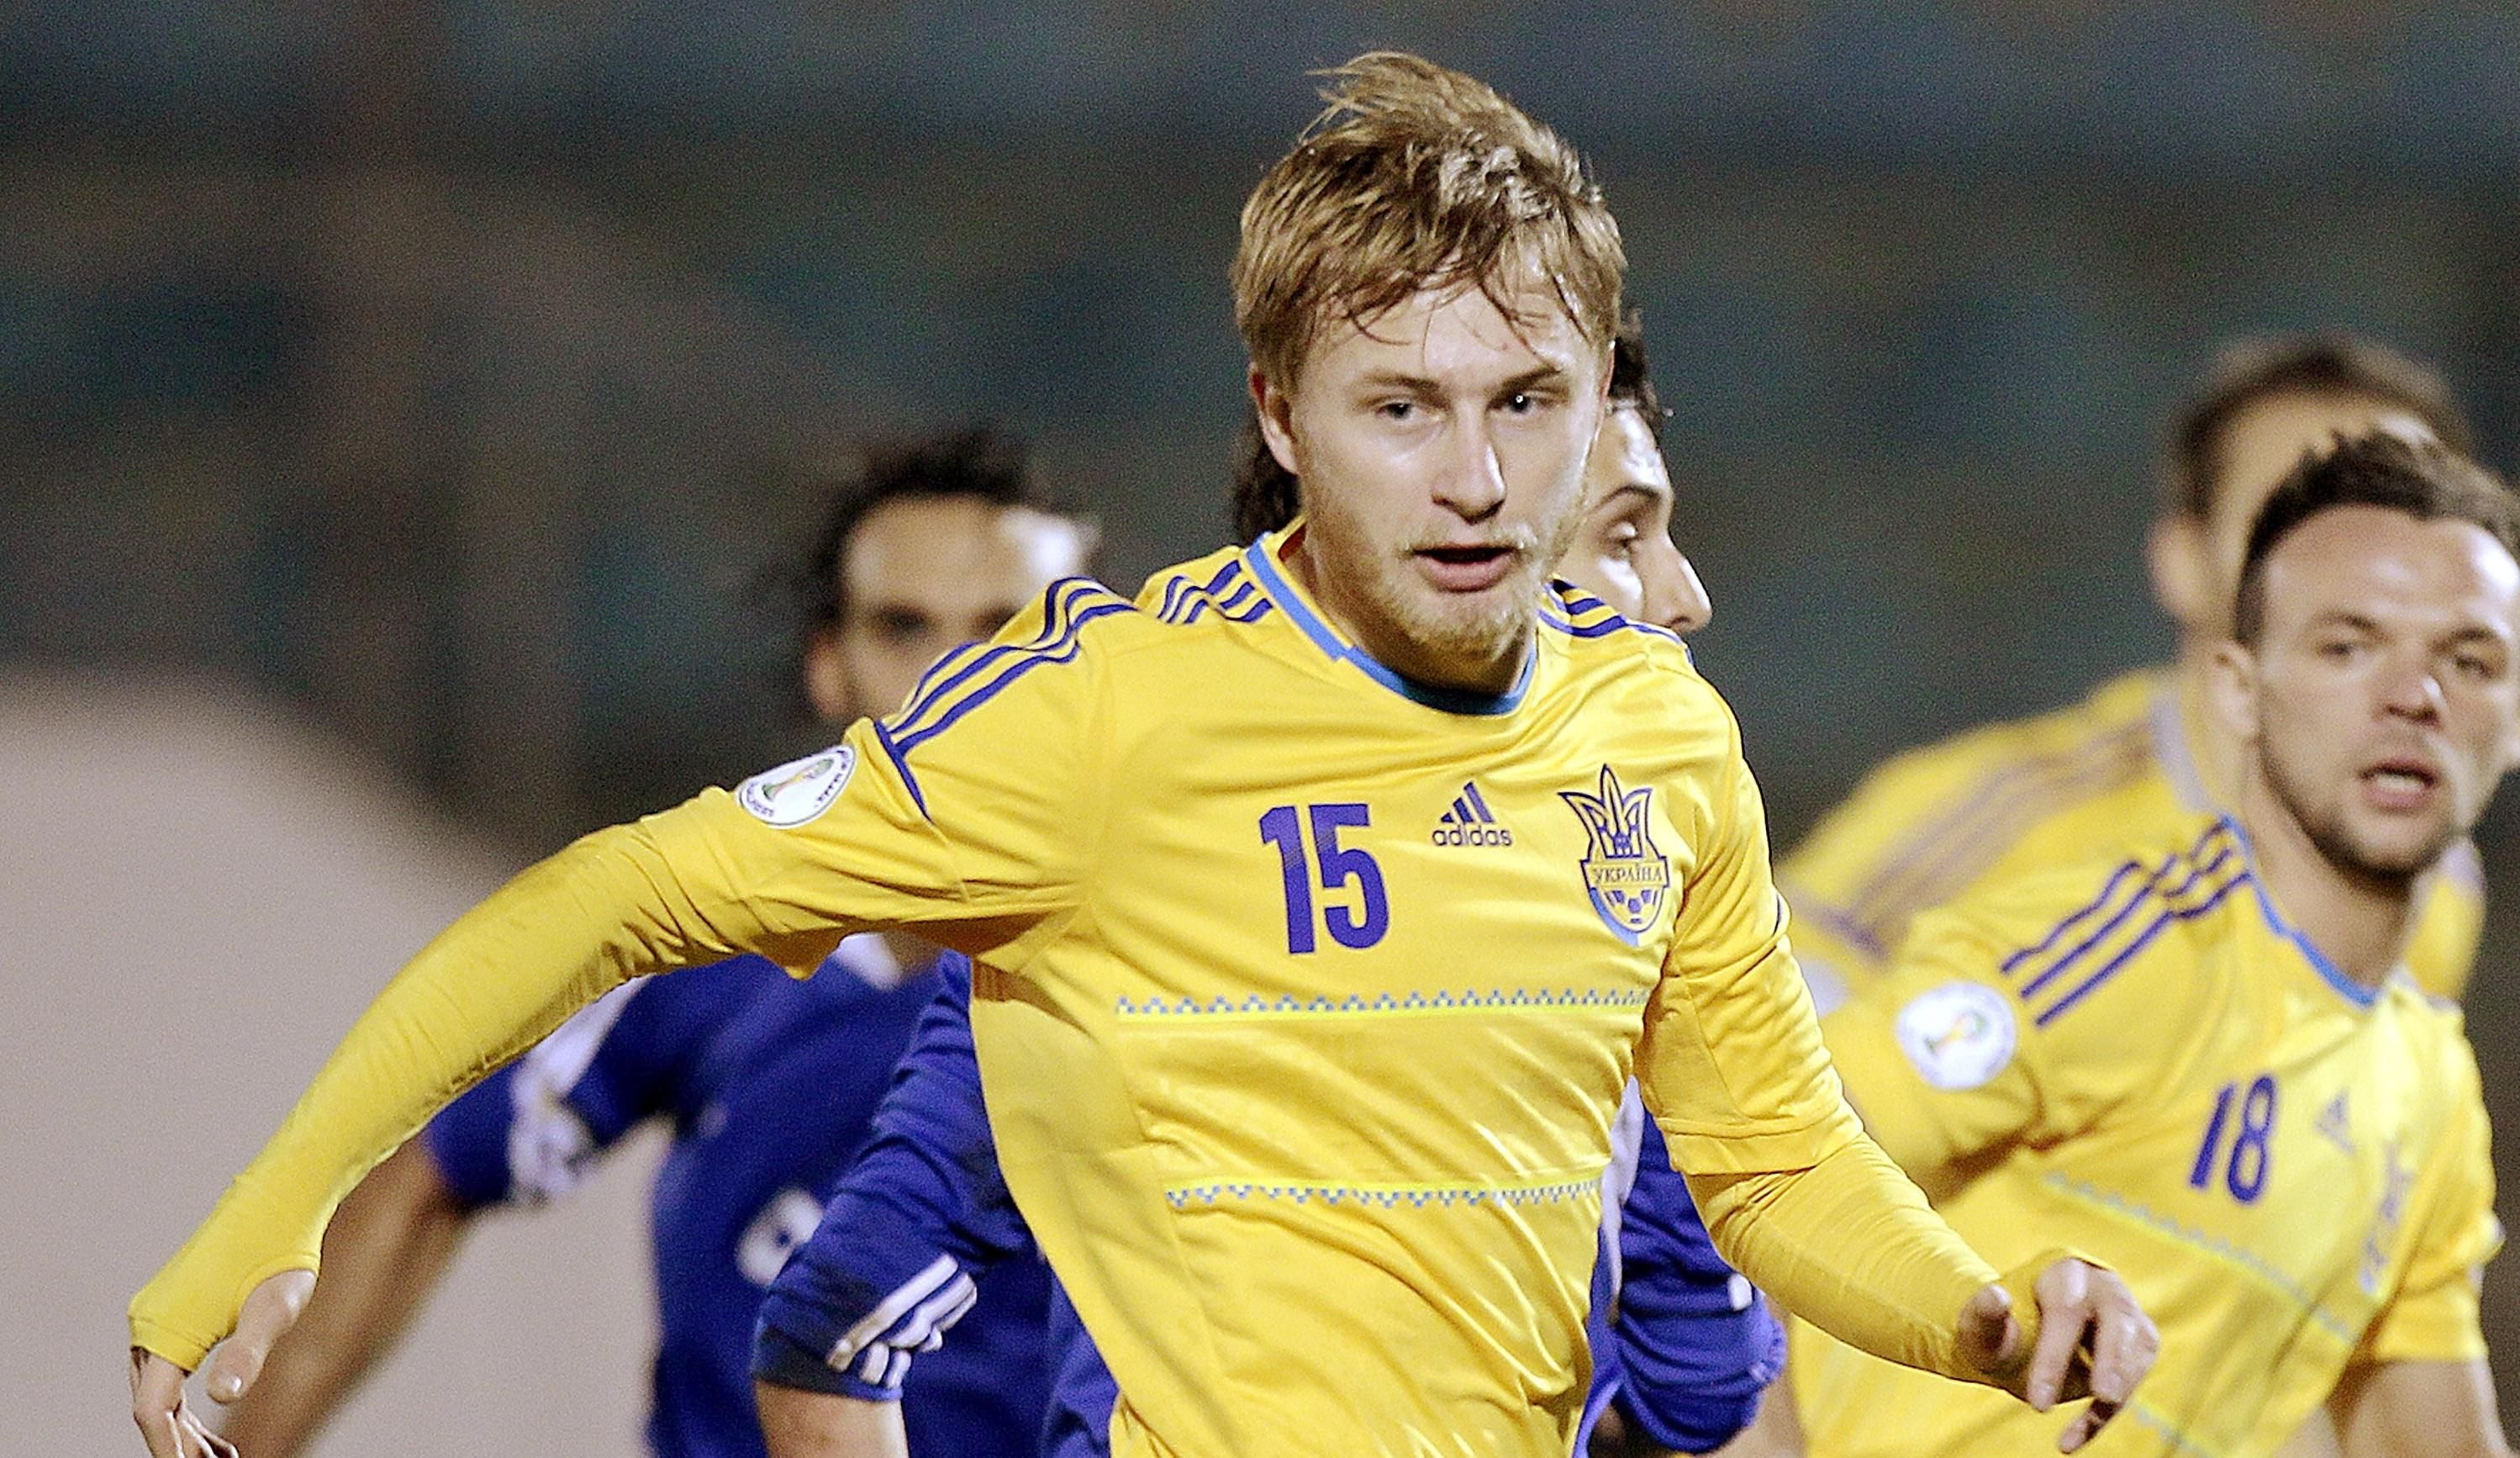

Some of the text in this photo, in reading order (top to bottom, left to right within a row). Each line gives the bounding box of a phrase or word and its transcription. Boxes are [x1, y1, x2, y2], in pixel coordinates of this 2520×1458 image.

[1431, 824, 1512, 847] adidas
[1260, 803, 1389, 954] 15
[1594, 862, 1662, 884] УКРАЇНА
[2191, 1077, 2275, 1202] 18
